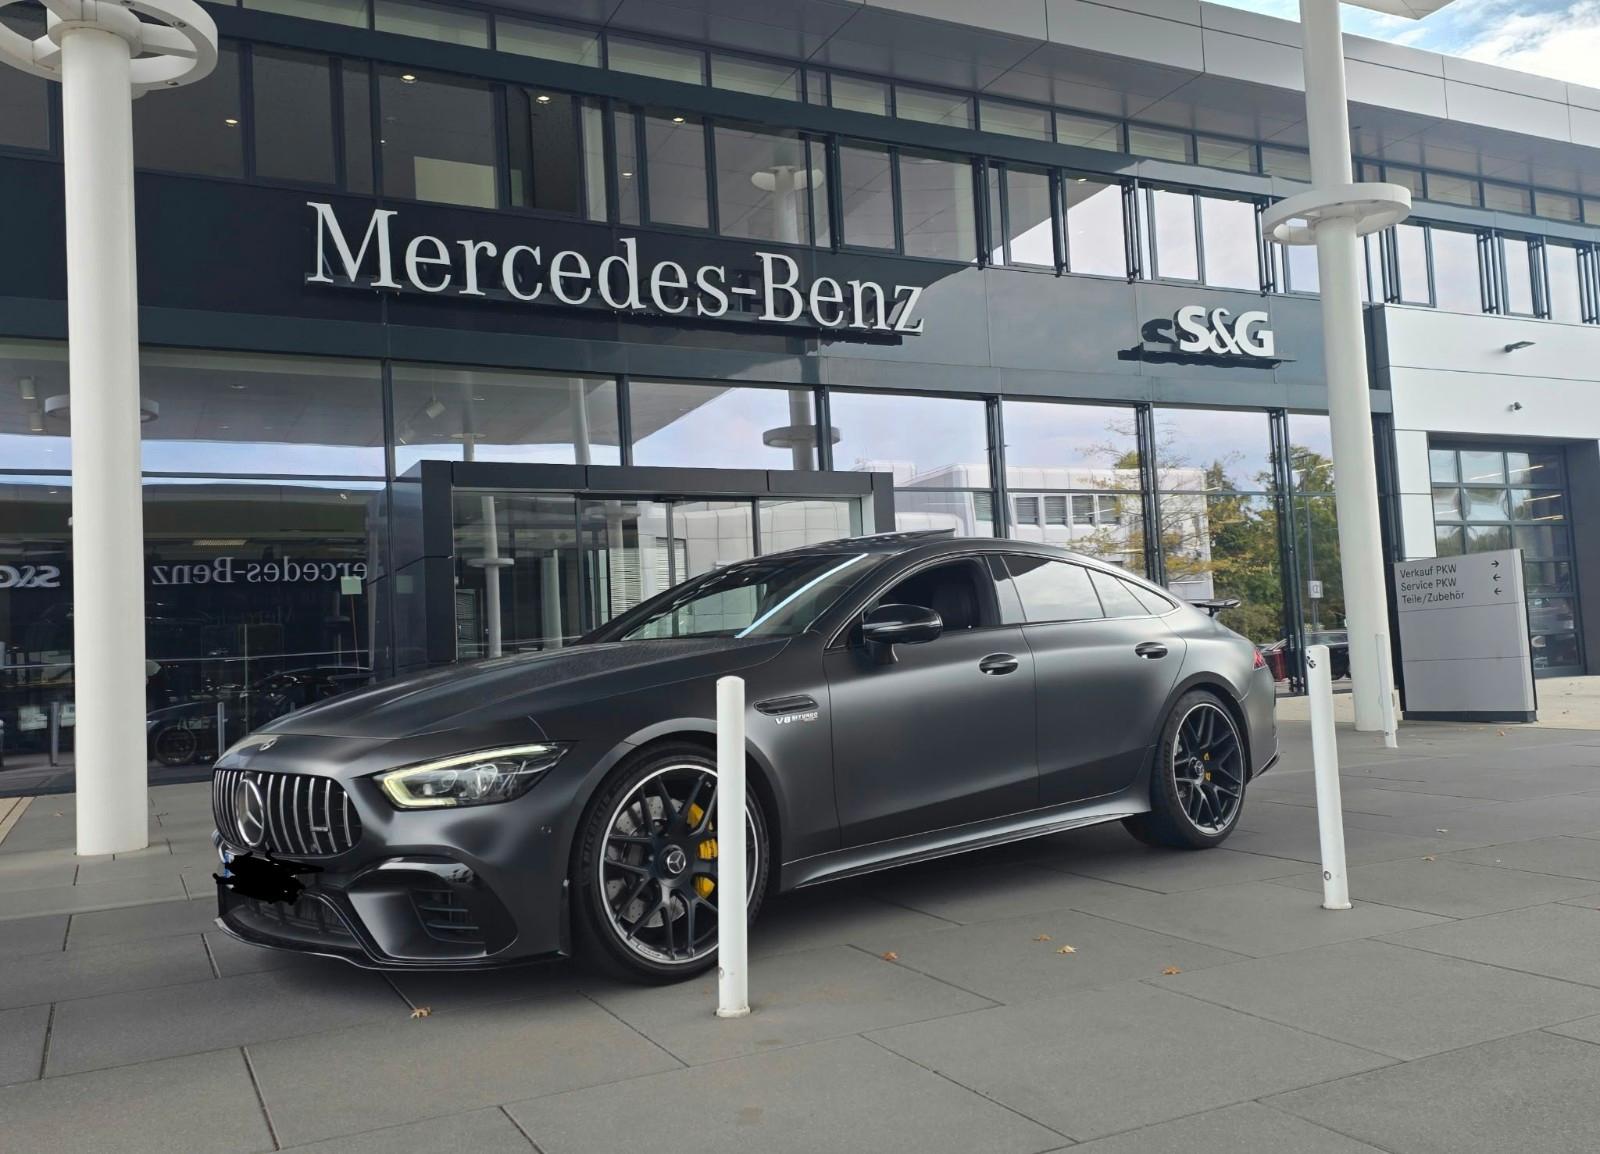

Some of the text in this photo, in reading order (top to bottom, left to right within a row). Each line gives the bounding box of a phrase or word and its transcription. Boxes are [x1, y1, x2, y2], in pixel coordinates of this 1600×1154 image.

[306, 201, 925, 335] Mercedes-Benz
[1177, 305, 1275, 357] S&G
[1400, 564, 1457, 578] Verkauf PKW
[1401, 578, 1457, 592] Service PKW
[1402, 590, 1465, 605] Teile/Zubehör
[775, 716, 791, 725] V8
